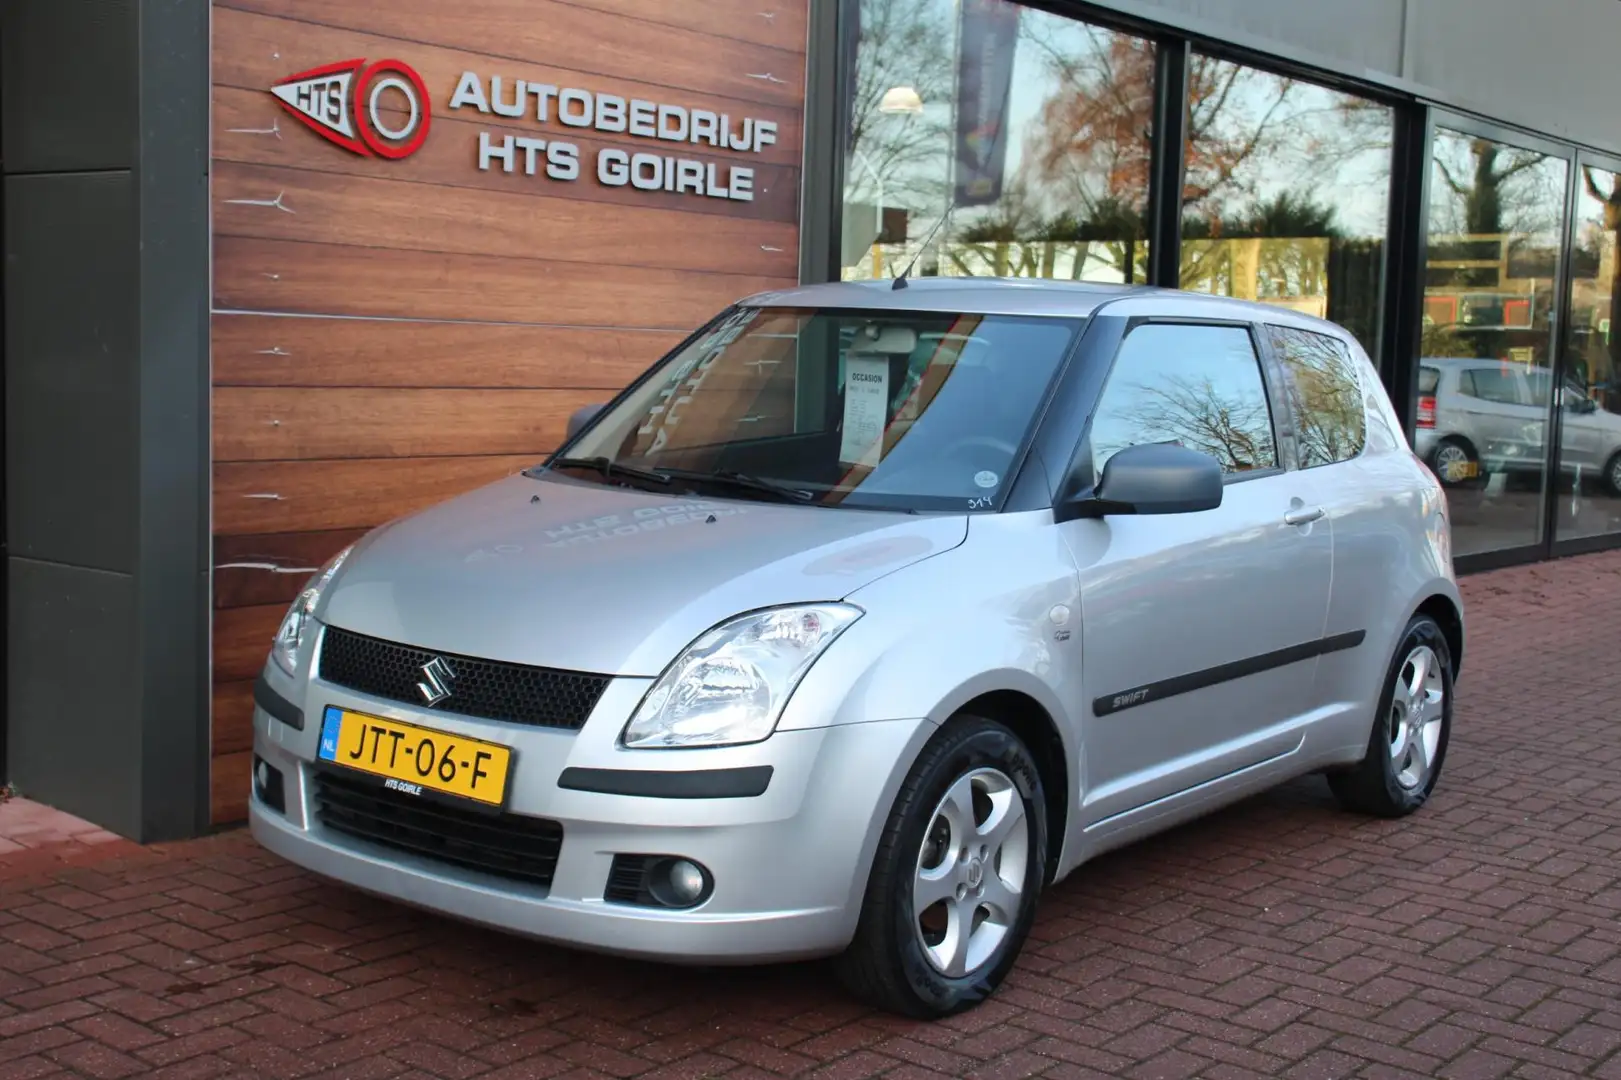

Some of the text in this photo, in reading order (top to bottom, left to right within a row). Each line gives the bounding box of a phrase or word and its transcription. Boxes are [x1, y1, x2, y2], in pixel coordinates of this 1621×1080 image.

[296, 80, 342, 125] HTS
[449, 71, 778, 153] AUTOBEDRIJF
[478, 131, 754, 201] HTS GOIRLE
[851, 372, 883, 384] OCCASION
[1112, 688, 1149, 709] SWIFT
[323, 738, 335, 752] NL
[349, 723, 492, 789] JTT-06-F
[384, 778, 398, 790] HTS
